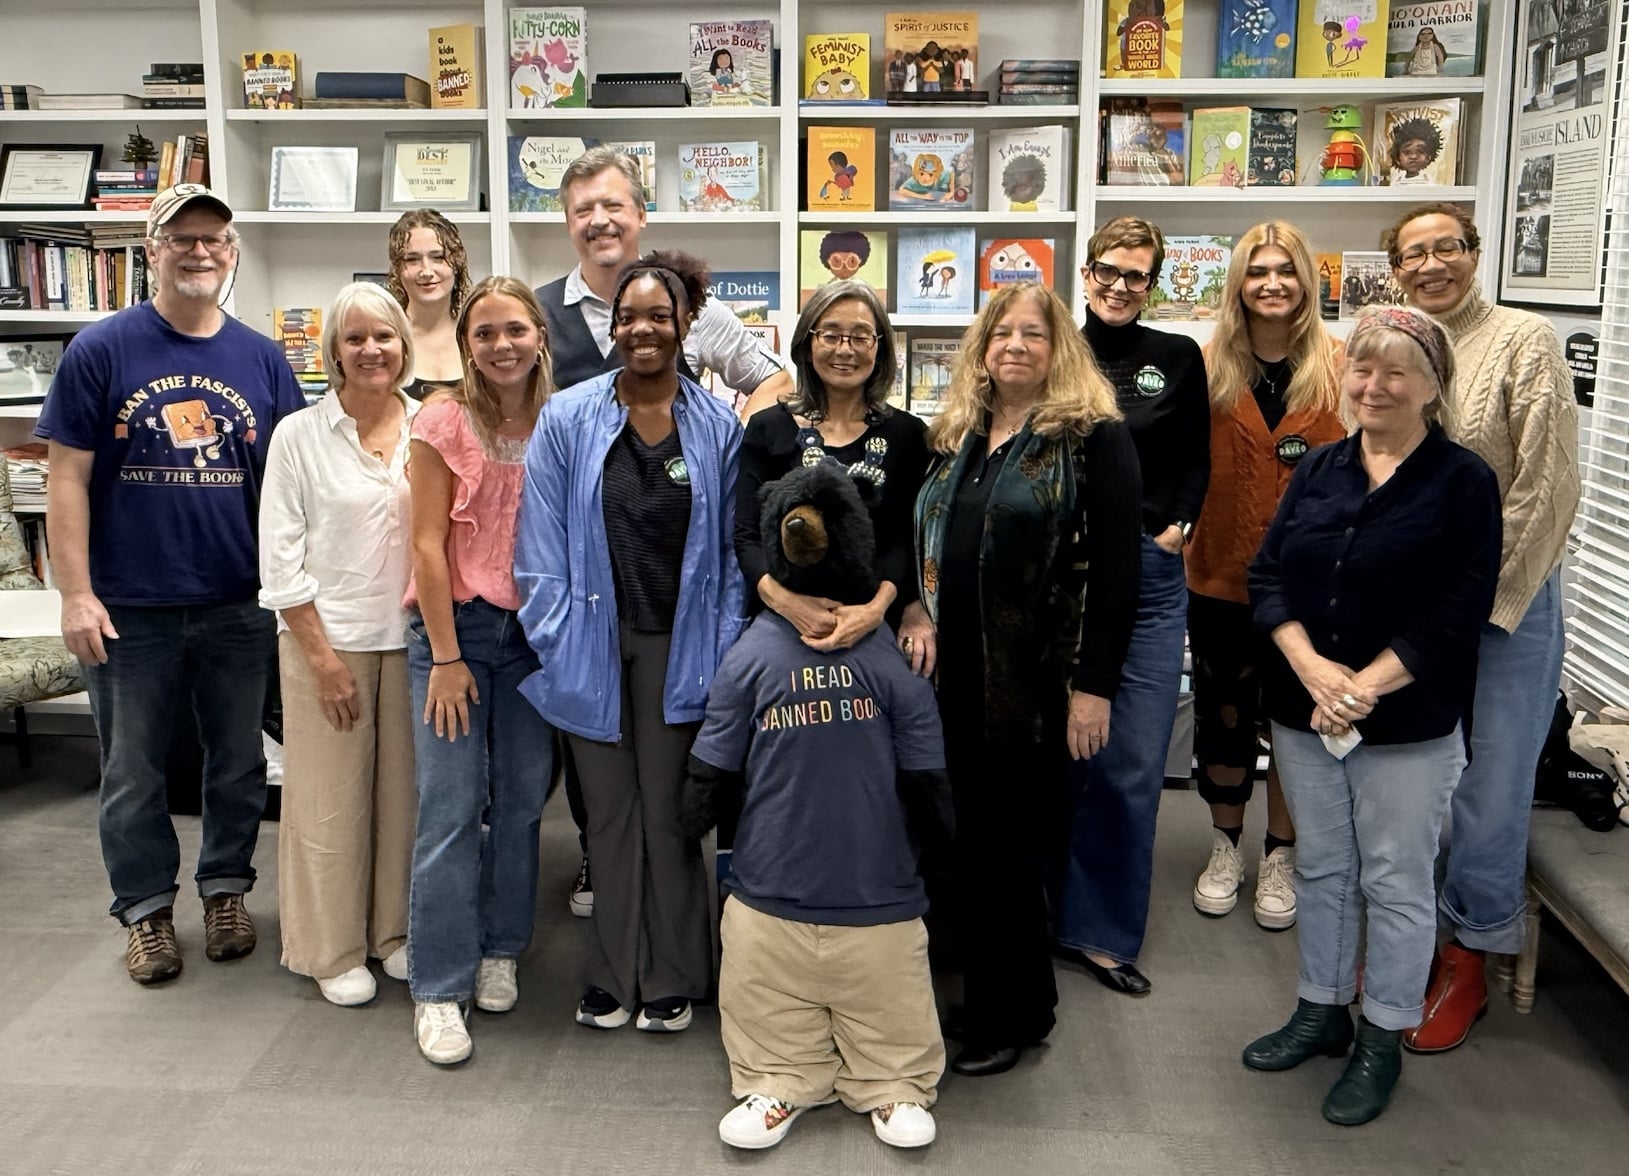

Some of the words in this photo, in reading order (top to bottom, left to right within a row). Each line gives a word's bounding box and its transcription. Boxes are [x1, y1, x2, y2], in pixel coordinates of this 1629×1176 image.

[1420, 13, 1473, 26] WARRIOR
[704, 24, 726, 35] Want
[736, 24, 758, 35] Read
[894, 22, 922, 31] SPIRIT
[931, 22, 969, 31] JUSTICE
[438, 46, 454, 55] kids
[692, 38, 717, 57] ALL
[717, 38, 730, 46] the
[732, 35, 767, 53] Books
[810, 41, 866, 58] FEMINIST
[1129, 40, 1159, 51] BOOK
[439, 56, 457, 66] book
[820, 53, 855, 66] BABY
[1128, 60, 1159, 69] WORLD
[437, 73, 469, 91] BANNED
[1555, 114, 1602, 147] ISLAND
[895, 132, 910, 144] ALL
[918, 132, 939, 144] WAY
[953, 133, 969, 144] TOP
[528, 142, 555, 156] Nigel
[683, 147, 732, 163] HELLO,
[694, 156, 753, 168] NEIGHBOR!
[1165, 248, 1183, 262] ing
[1190, 246, 1223, 262] BOOKS
[709, 281, 724, 295] of
[727, 281, 769, 296] Dottie
[117, 389, 149, 422] BAN
[148, 375, 186, 394] THE
[190, 375, 258, 428] FASCISTS
[120, 470, 158, 482] SAVE
[162, 471, 196, 483] THE
[790, 670, 797, 693] I
[802, 664, 853, 691] READ
[1567, 770, 1605, 779] SONY
